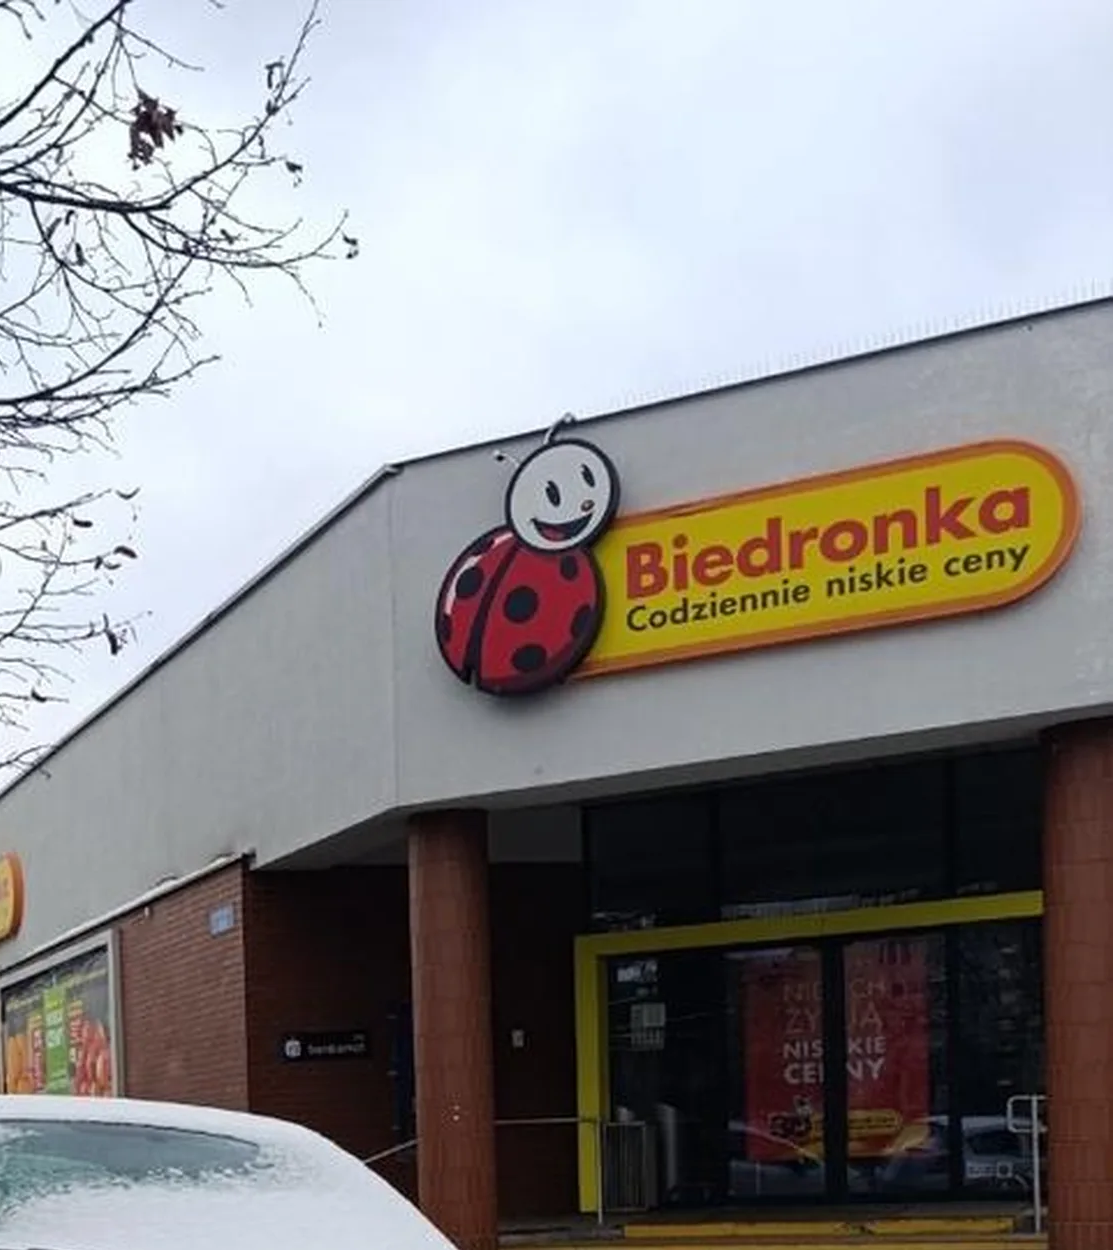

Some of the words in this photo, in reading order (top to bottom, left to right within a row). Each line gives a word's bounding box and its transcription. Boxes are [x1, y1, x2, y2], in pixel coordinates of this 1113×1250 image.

[625, 485, 1031, 600] Biedronka
[626, 580, 811, 633] Codziennie
[827, 561, 928, 599] niskie
[944, 542, 1031, 582] ceny
